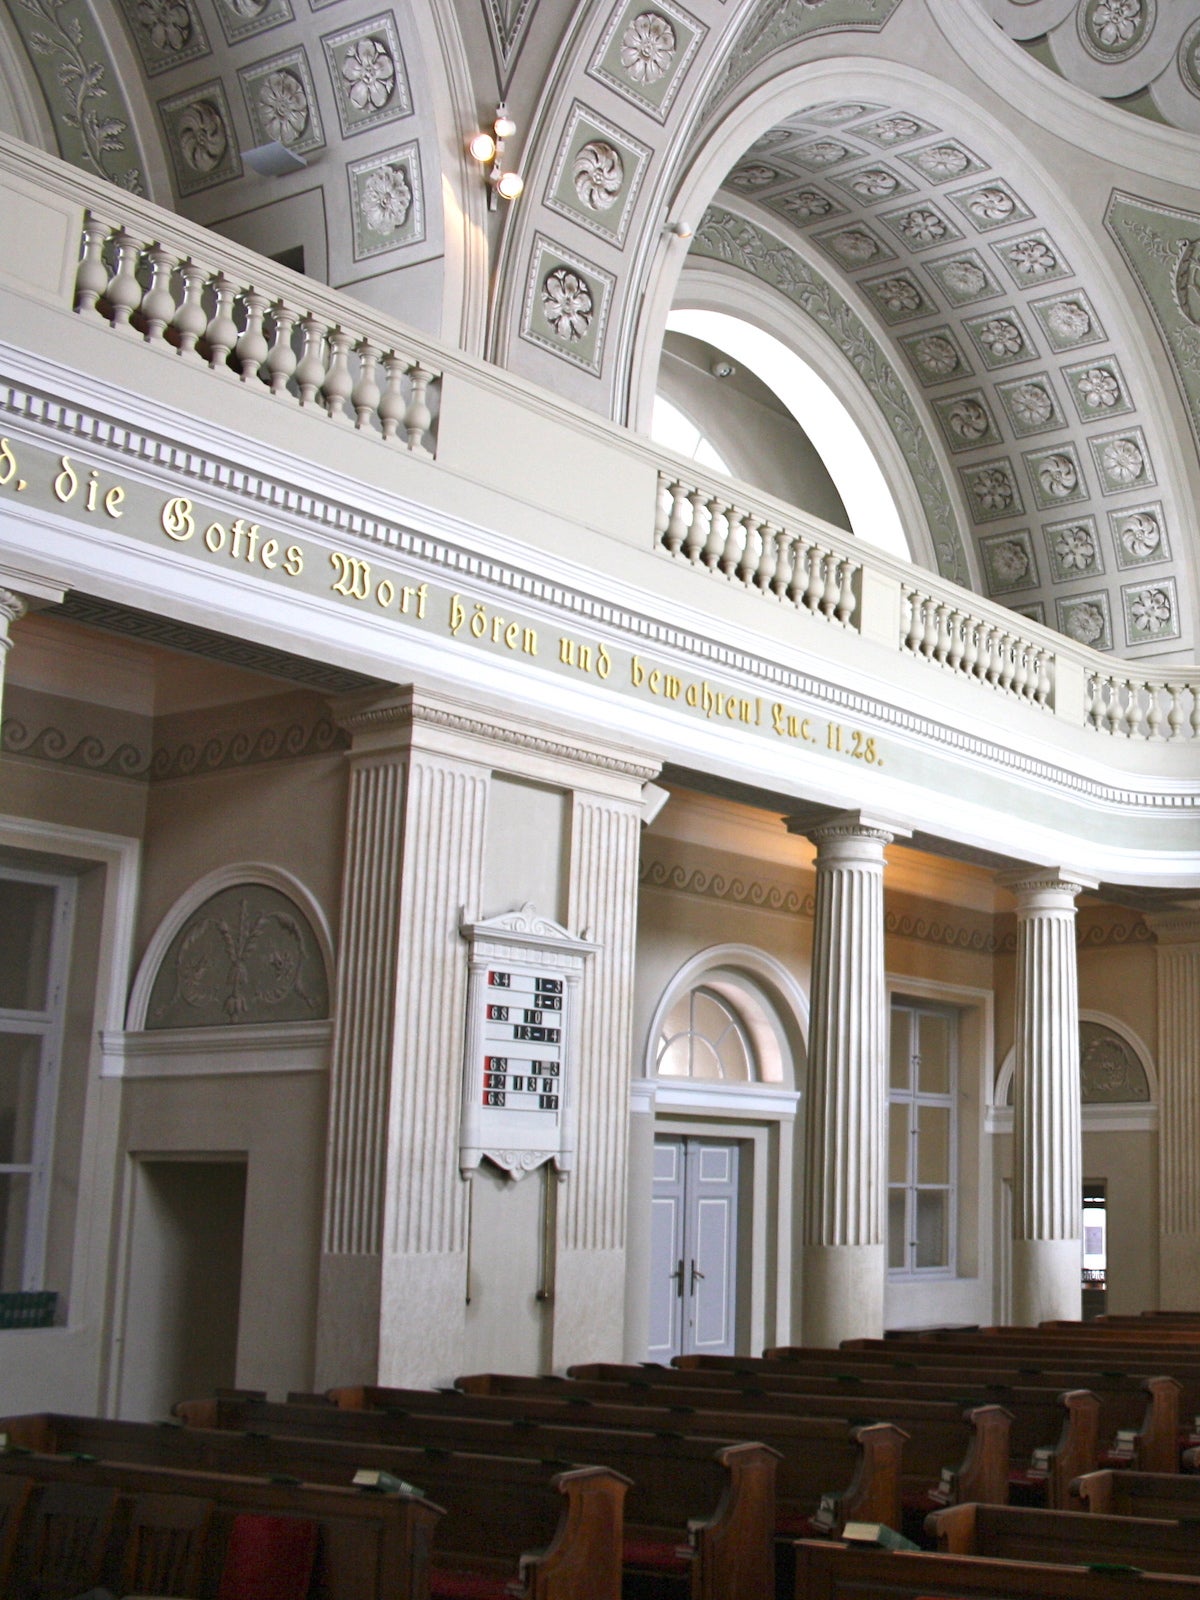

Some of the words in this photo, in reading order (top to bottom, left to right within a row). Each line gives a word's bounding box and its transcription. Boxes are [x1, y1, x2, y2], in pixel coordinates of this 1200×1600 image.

[54, 456, 126, 518] die
[161, 497, 304, 576] Gottes
[330, 551, 429, 620] Wort
[448, 594, 538, 657] hören
[558, 636, 612, 680] und
[631, 655, 762, 726] bewahren!
[771, 702, 817, 745] Luc.
[493, 972, 510, 987] 84
[491, 1006, 508, 1021] 68
[527, 1010, 542, 1024] 10
[490, 1057, 507, 1072] 68
[488, 1075, 505, 1089] 42
[487, 1091, 505, 1106] 68
[542, 1095, 557, 1109] 17
